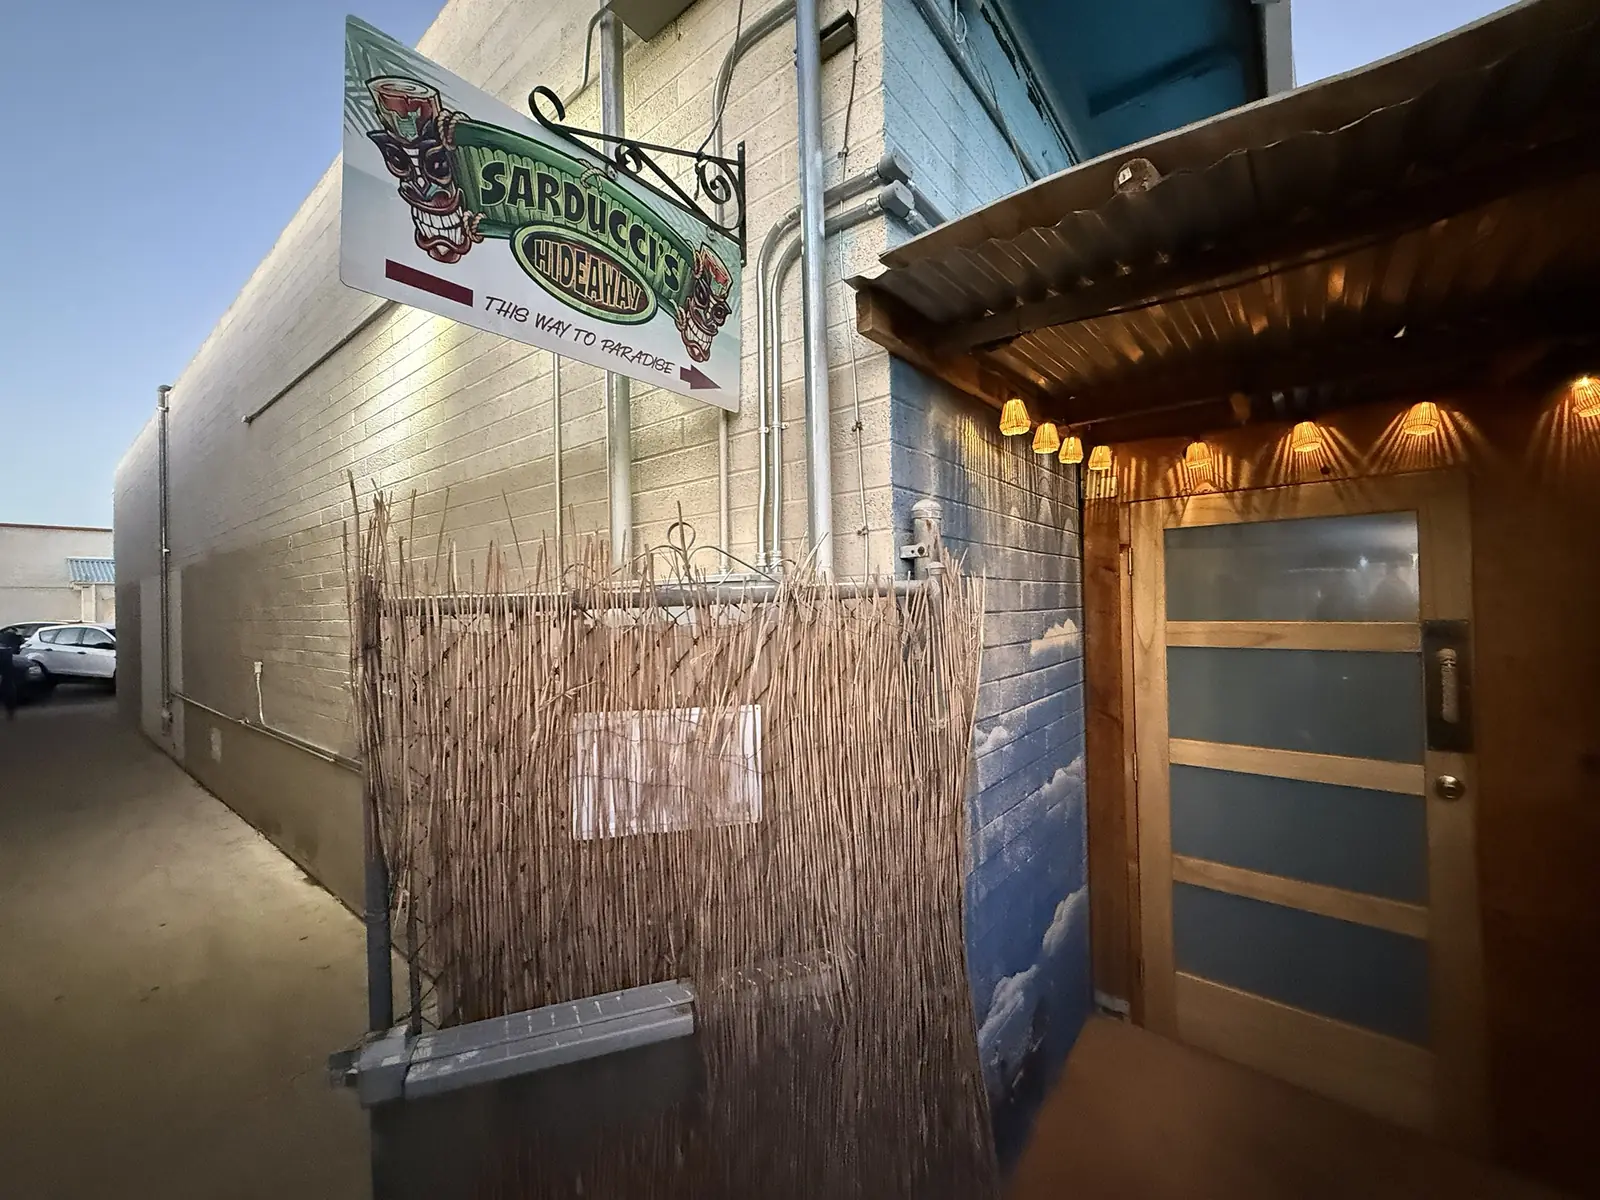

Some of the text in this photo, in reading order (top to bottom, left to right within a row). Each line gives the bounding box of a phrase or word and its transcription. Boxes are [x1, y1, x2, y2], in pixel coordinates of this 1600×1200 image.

[480, 161, 681, 293] SARDUCCI'S
[534, 239, 643, 312] HIDEAWAY
[485, 296, 676, 375] THIS WAY TO PARADISE
